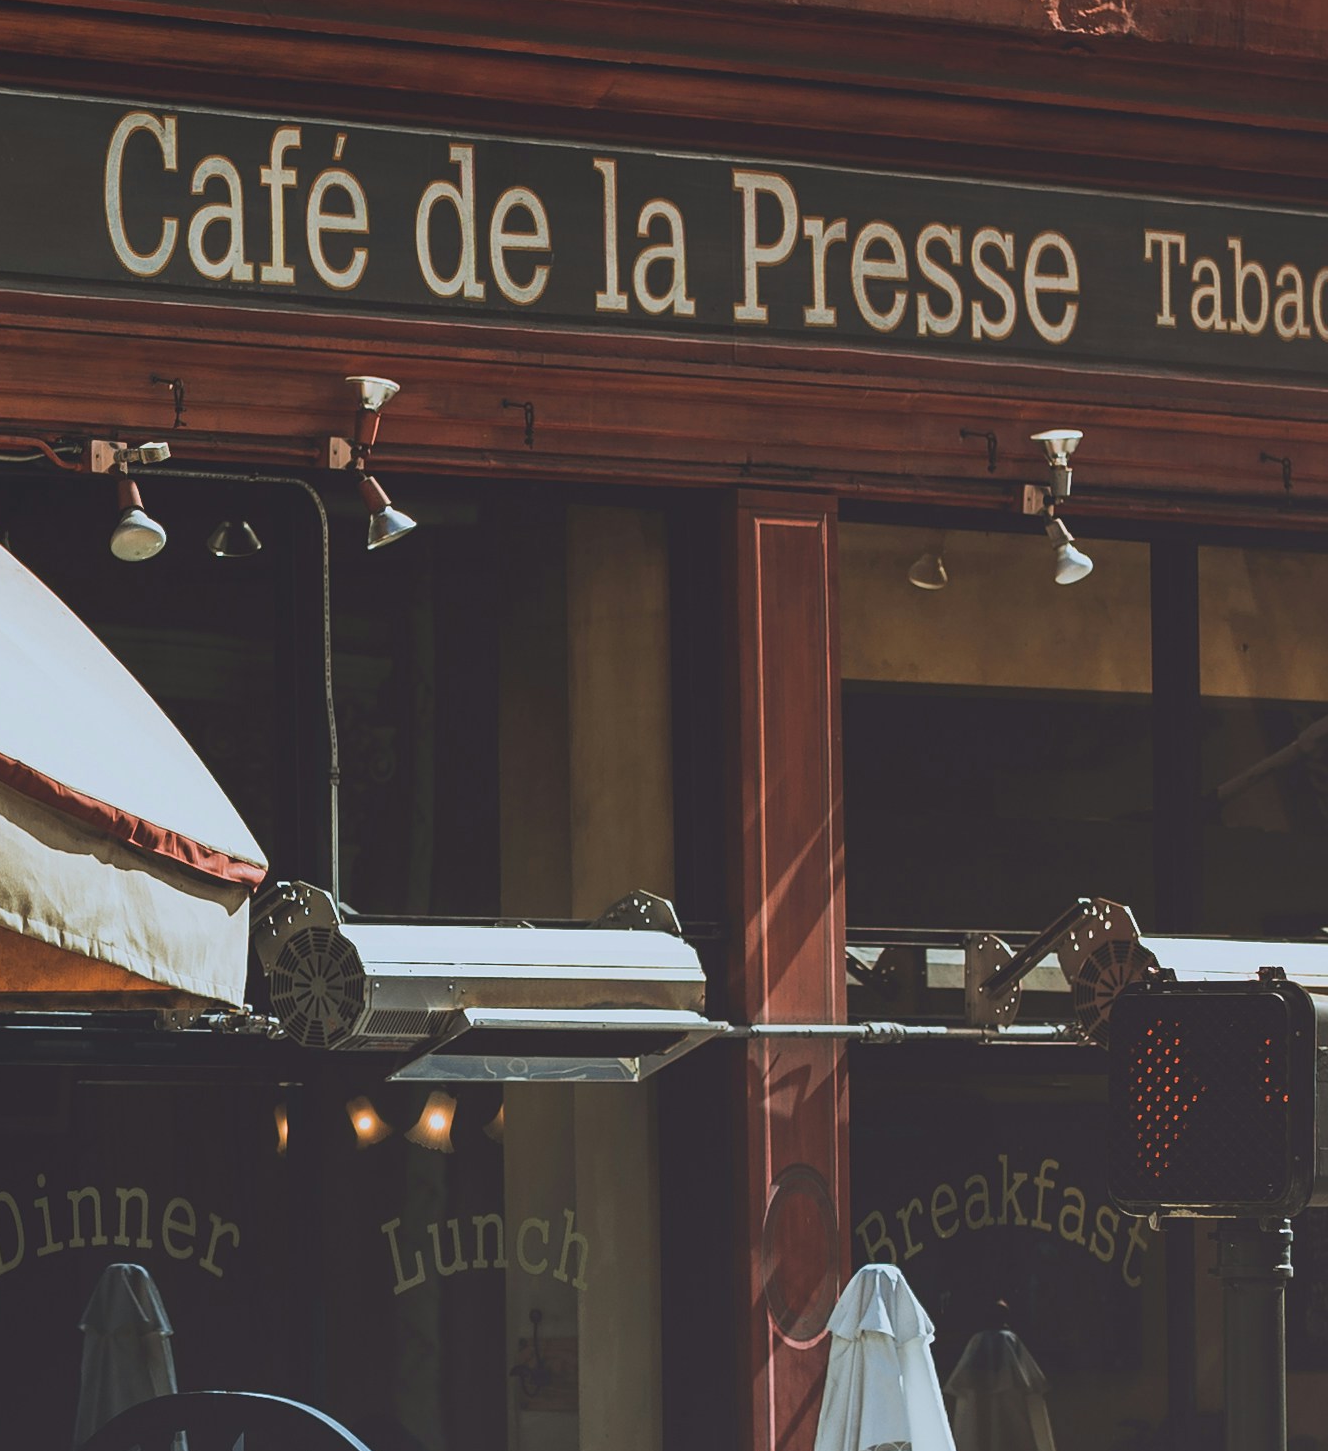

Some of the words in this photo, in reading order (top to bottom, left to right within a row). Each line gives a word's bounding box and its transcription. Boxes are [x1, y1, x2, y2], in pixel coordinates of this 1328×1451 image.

[102, 110, 370, 292] Café
[414, 141, 553, 307] de
[591, 156, 697, 318] la
[731, 167, 1081, 345] Presse
[380, 1207, 590, 1296] Lunch
[856, 1154, 1150, 1288] Breakfast
